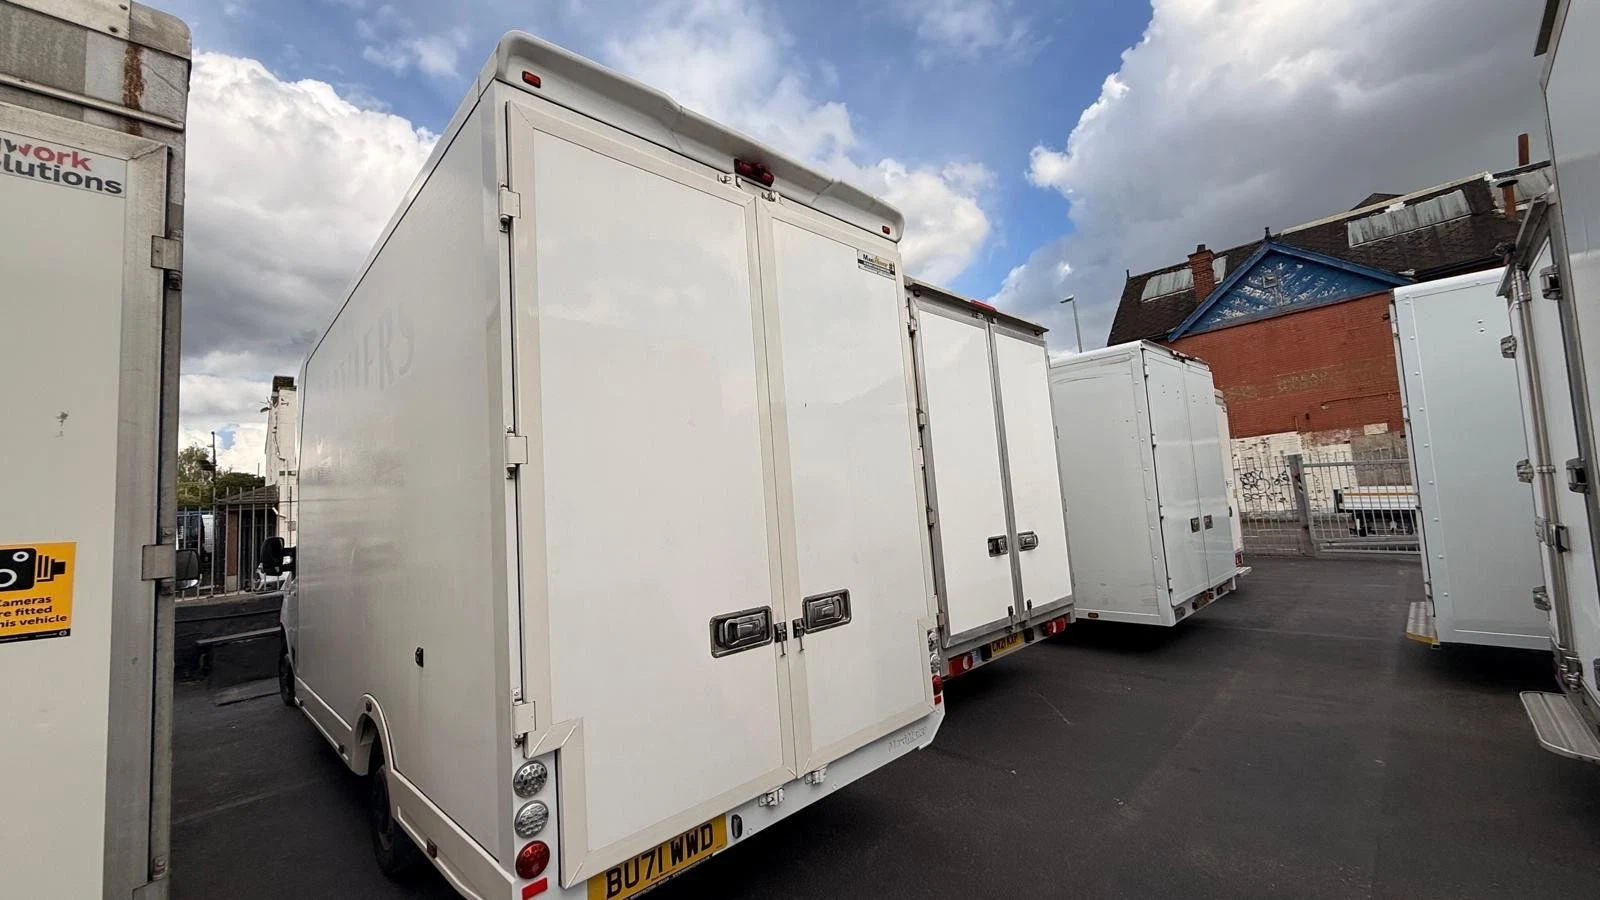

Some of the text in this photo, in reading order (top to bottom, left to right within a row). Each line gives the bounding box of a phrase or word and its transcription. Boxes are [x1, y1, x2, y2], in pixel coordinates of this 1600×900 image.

[0, 138, 91, 171] work
[0, 153, 122, 194] lutions
[15, 606, 52, 616] fitted
[20, 615, 67, 625] vehicle
[606, 846, 663, 899] BU71
[670, 823, 713, 867] WWD
